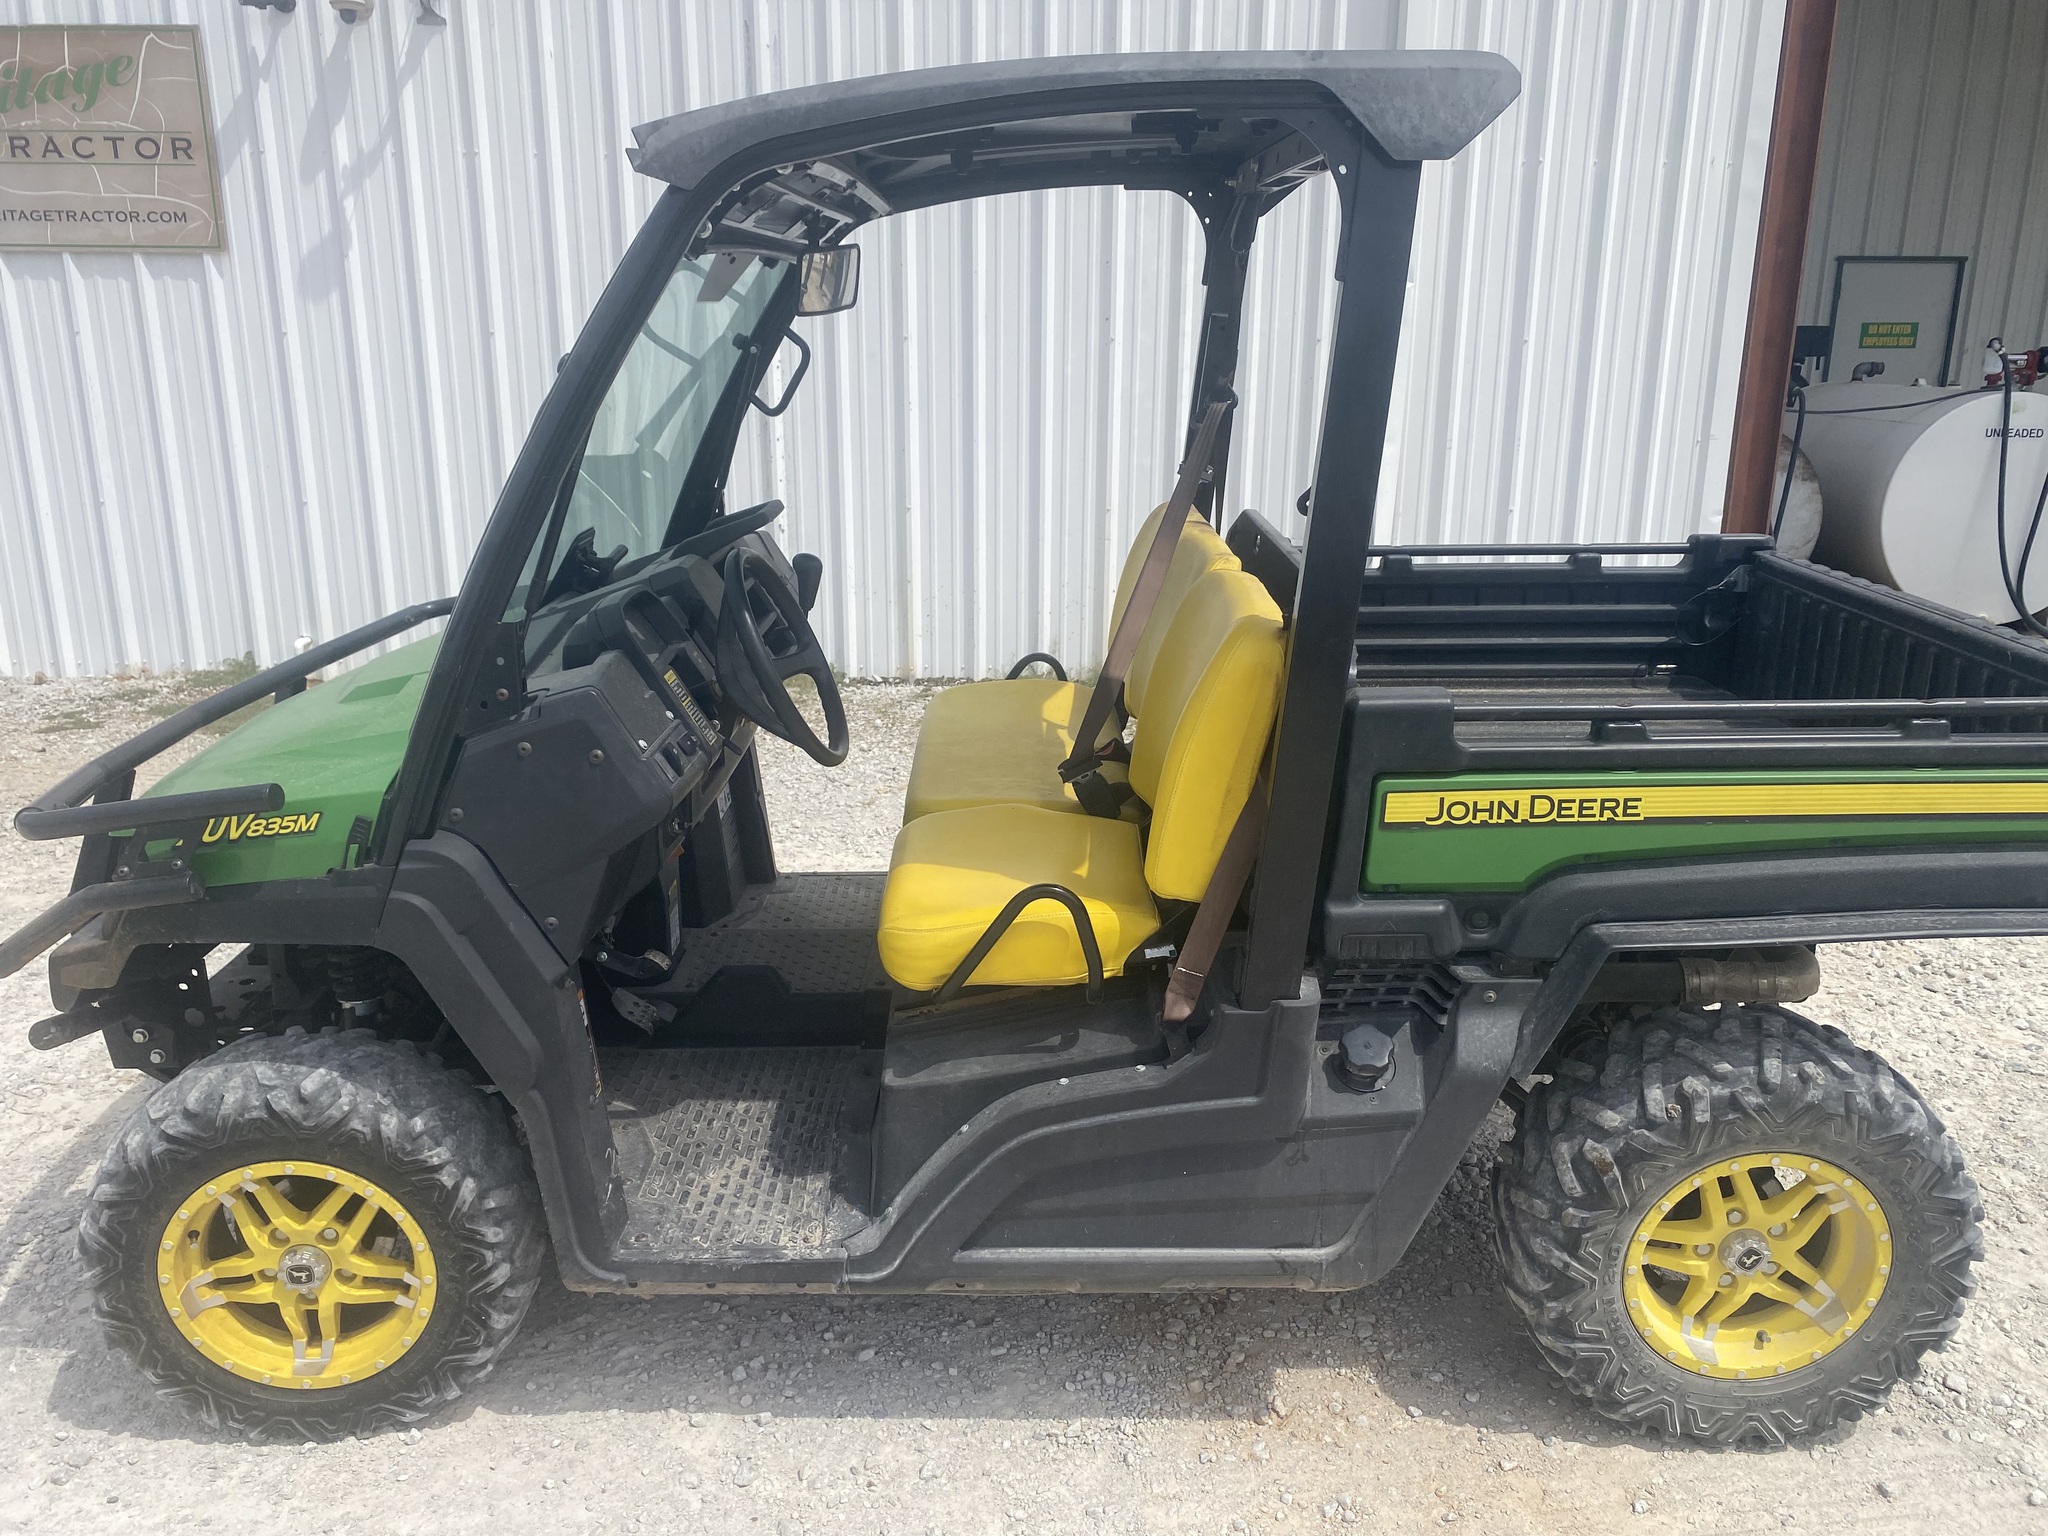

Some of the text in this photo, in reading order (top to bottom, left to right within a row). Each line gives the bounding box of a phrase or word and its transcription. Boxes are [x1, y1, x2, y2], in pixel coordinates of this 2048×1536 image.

[8, 135, 194, 161] RACTOR
[0, 209, 188, 224] ITAGETRACTOR.COM
[1868, 324, 1912, 334] DO NOT ENTER
[1862, 336, 1915, 346] EMPLOYEES ONLY
[1985, 427, 2044, 438] UNEADED
[1425, 794, 1643, 821] JOHN DEERE
[201, 812, 321, 843] UV835M
[1602, 1297, 1683, 1395] BIGHORN
